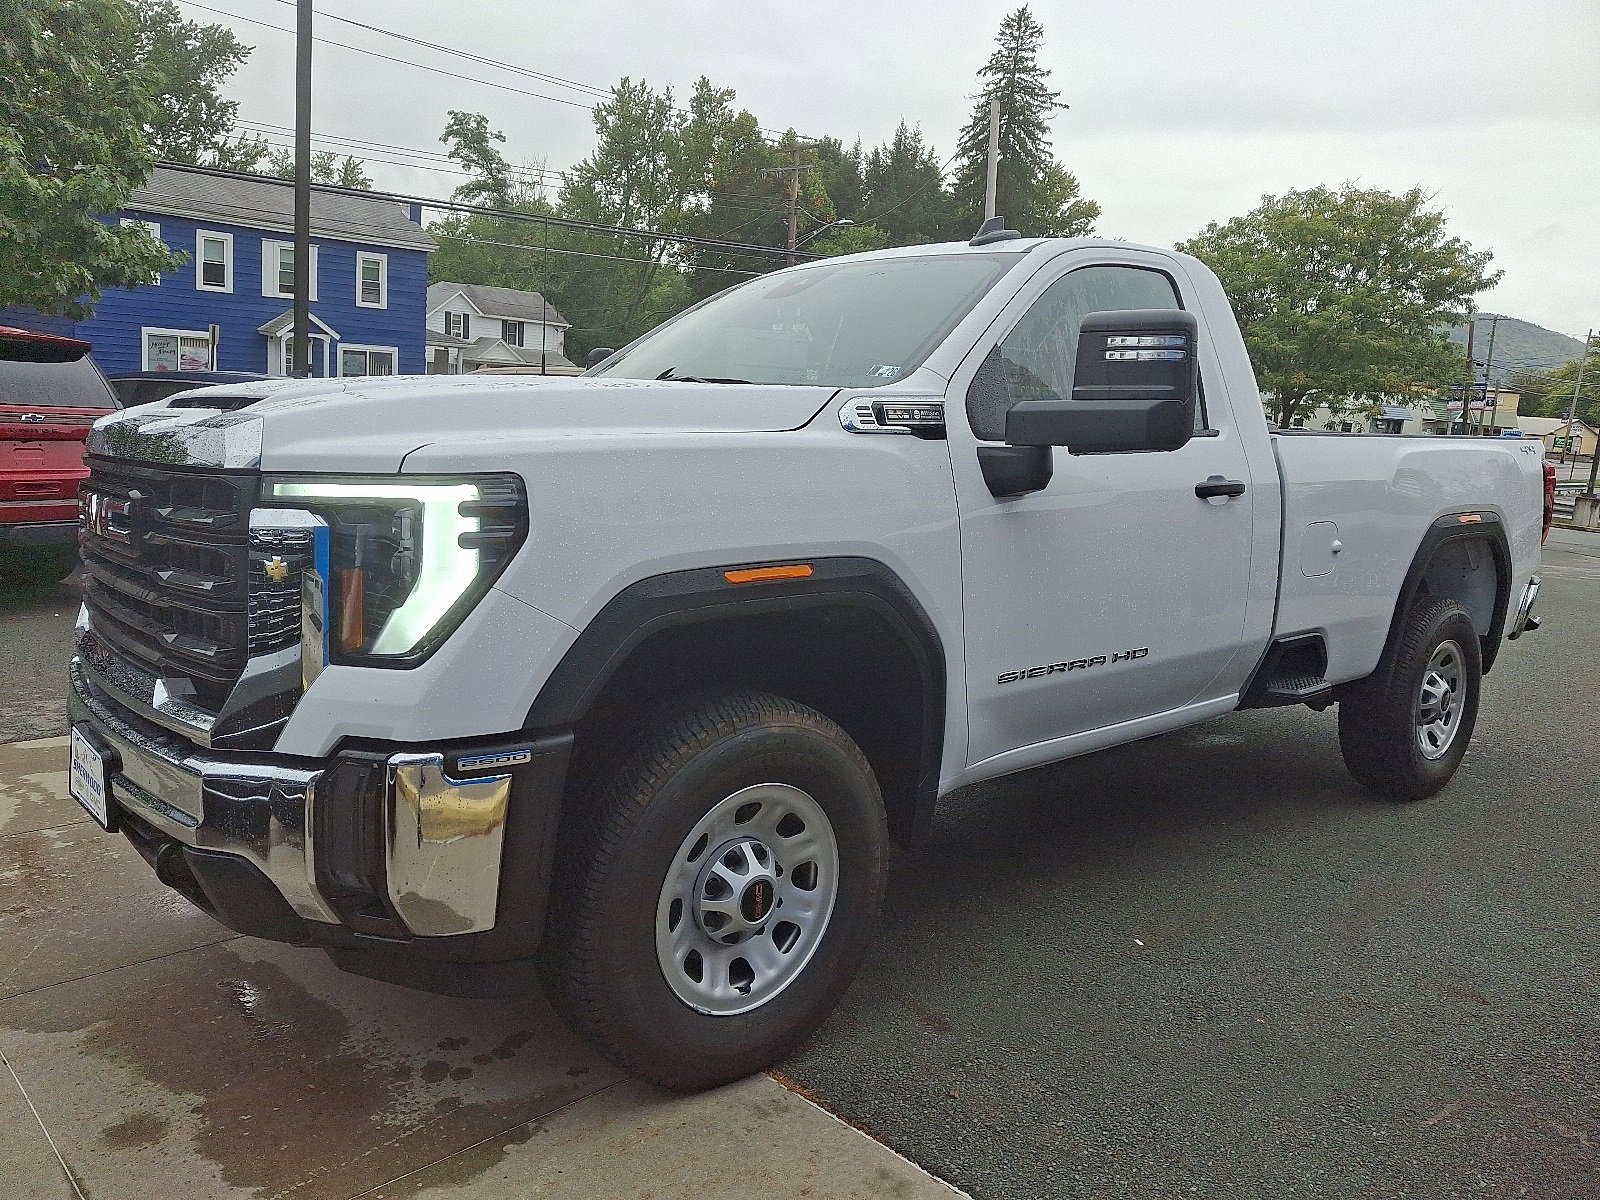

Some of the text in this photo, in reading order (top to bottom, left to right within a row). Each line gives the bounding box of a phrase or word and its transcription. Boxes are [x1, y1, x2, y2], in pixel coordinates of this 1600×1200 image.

[997, 646, 1150, 685] SIERRA HD
[461, 752, 528, 768] 2500
